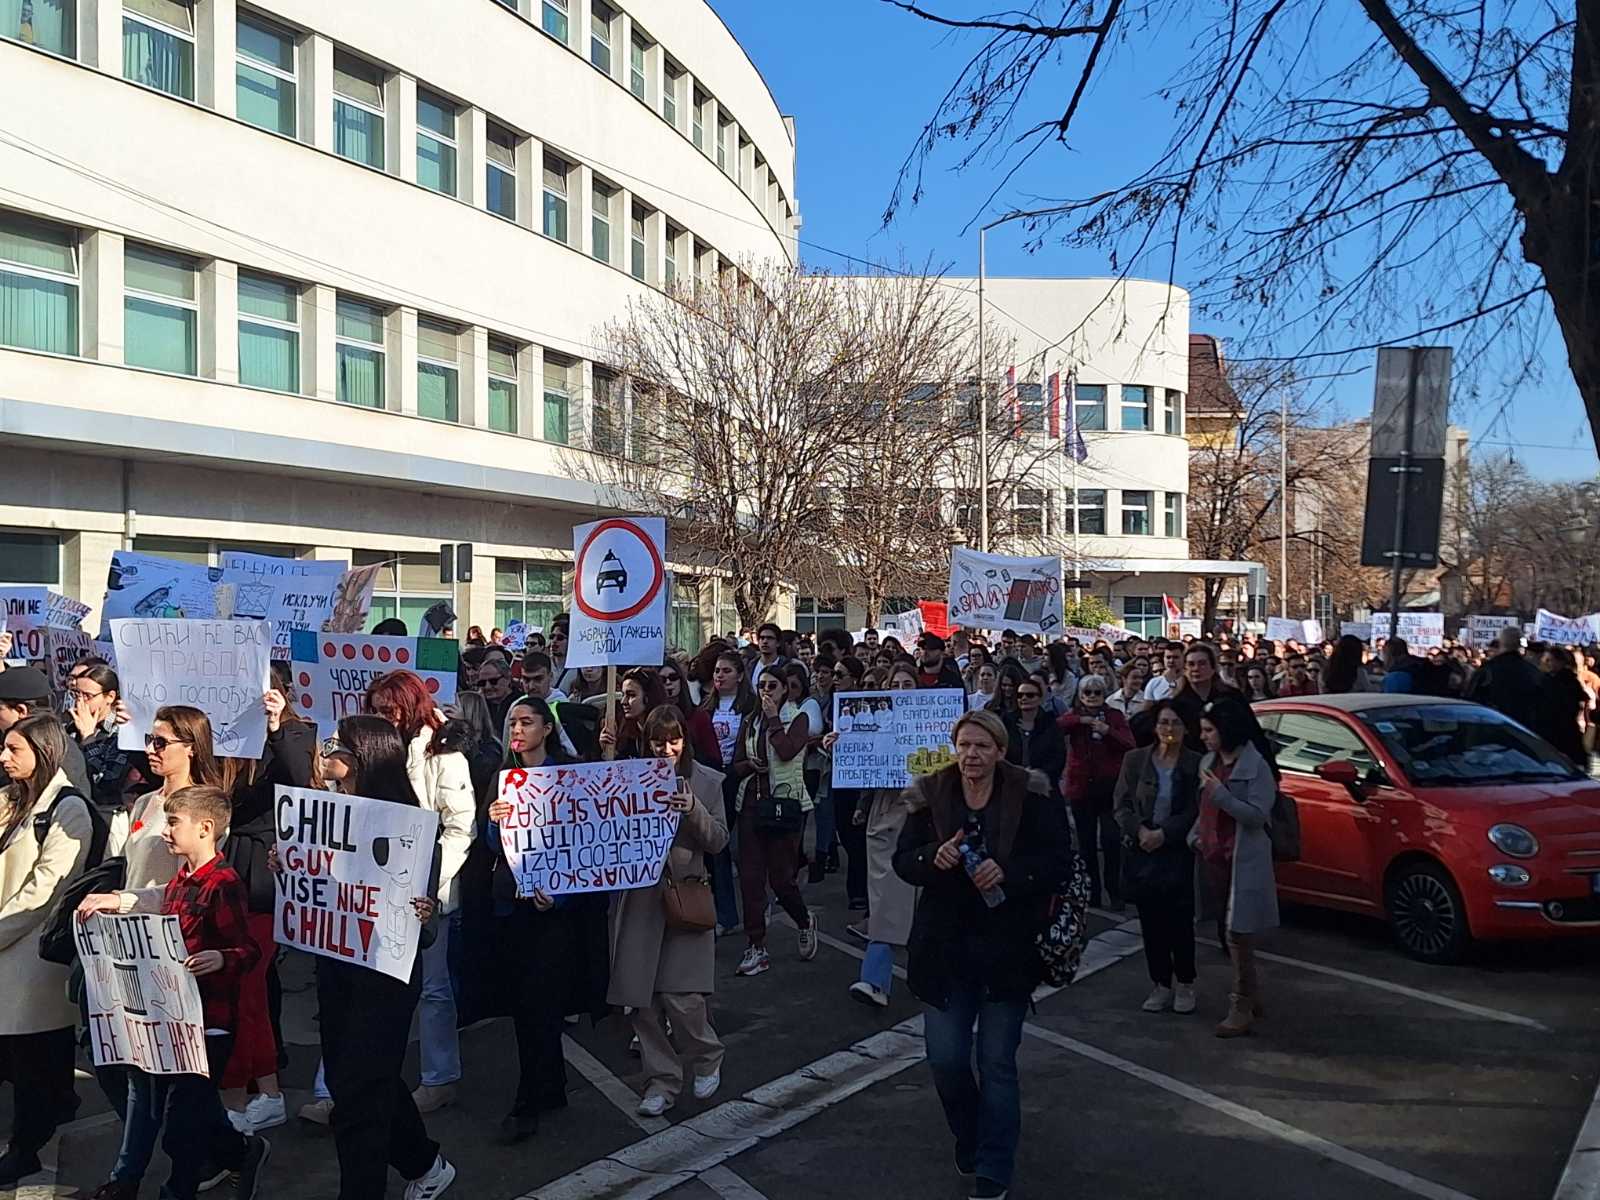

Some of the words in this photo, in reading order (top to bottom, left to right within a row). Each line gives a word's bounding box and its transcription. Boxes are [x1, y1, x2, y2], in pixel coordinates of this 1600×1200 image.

[120, 621, 190, 648] СТИЋИ
[201, 622, 223, 646] ЋЕ
[233, 623, 263, 647] ВАС
[275, 633, 289, 645] СЕ
[620, 625, 664, 640] ГАЖЕЊА
[150, 650, 250, 679] ПРАВДА
[127, 681, 167, 703] КАО
[277, 794, 357, 853] CHILL
[566, 798, 589, 825] SE
[285, 845, 334, 876] GUY
[578, 844, 604, 868] OD
[608, 841, 631, 865] JE
[275, 868, 328, 908] VIŠE
[336, 879, 381, 918] NIJE
[282, 901, 375, 961] CHILL!
